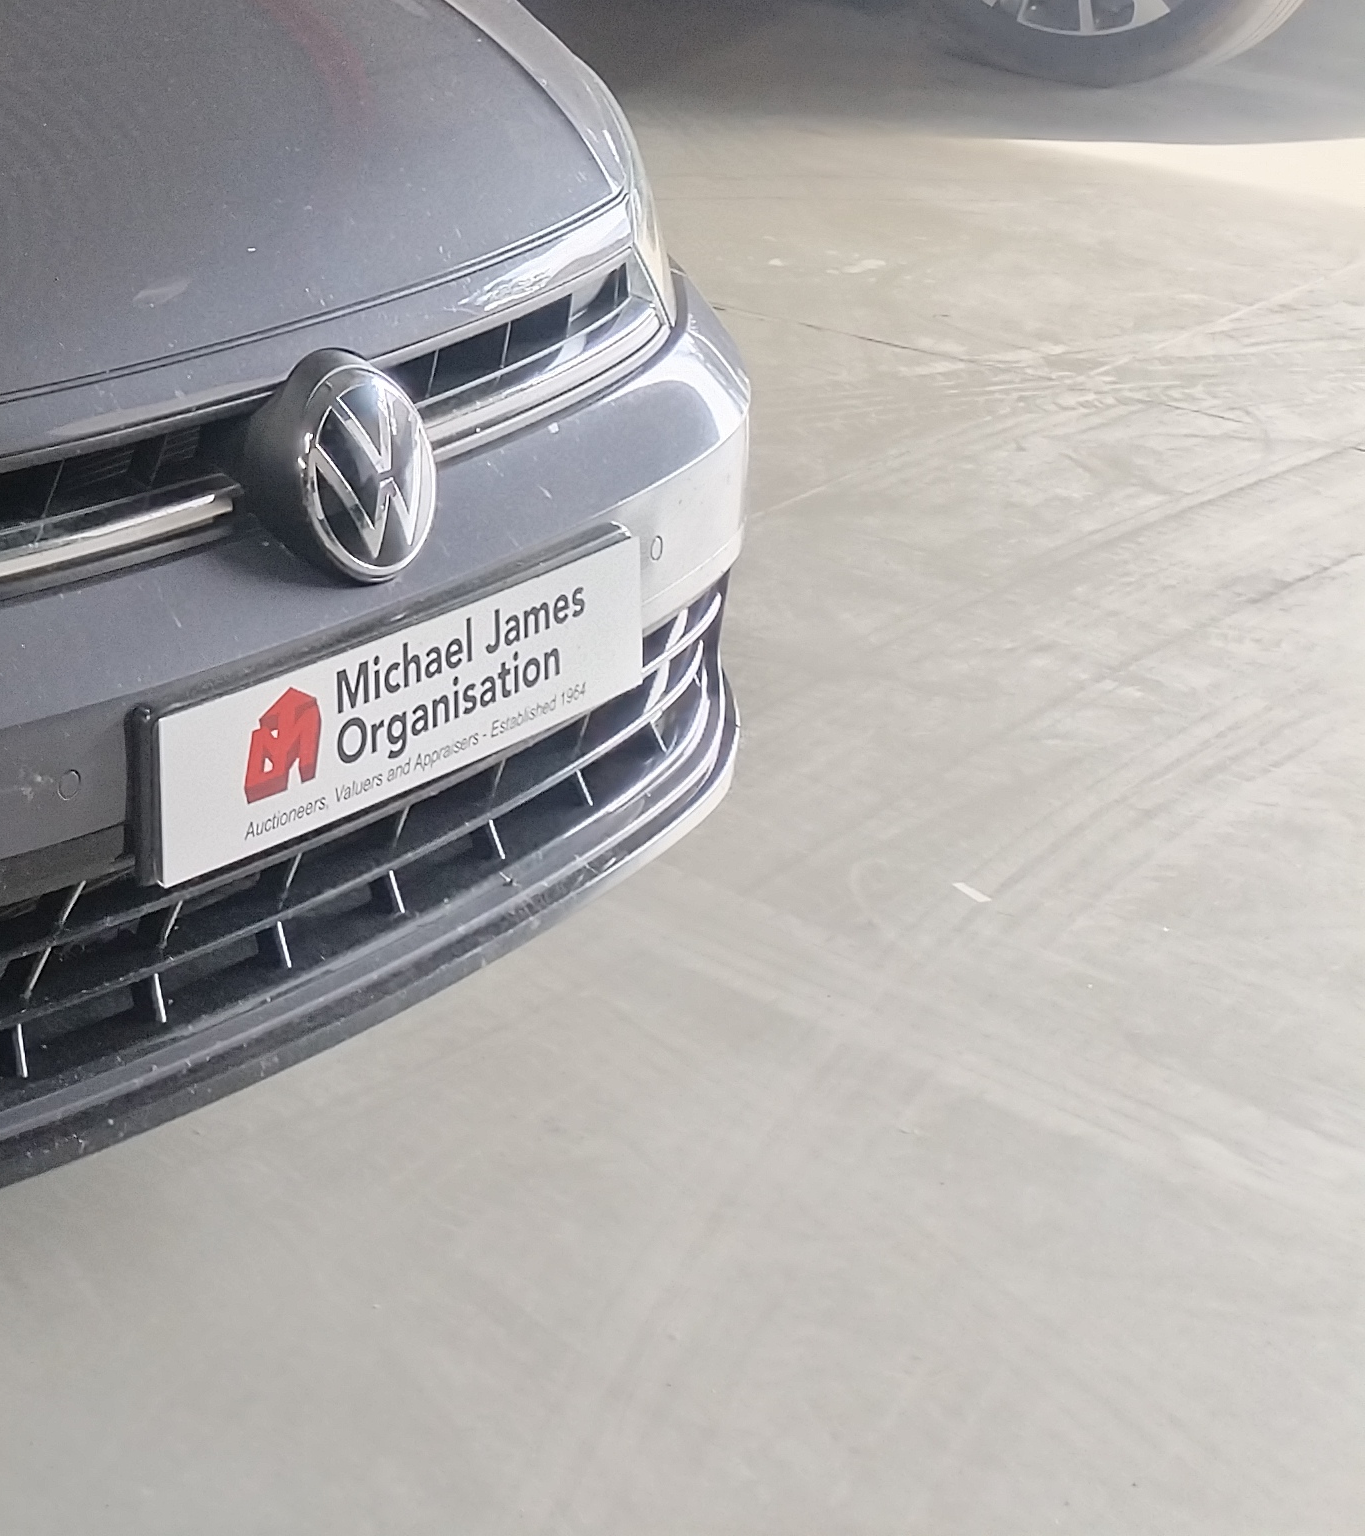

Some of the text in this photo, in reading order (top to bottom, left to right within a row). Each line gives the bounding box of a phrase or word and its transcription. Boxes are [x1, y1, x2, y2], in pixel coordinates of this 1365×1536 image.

[336, 583, 586, 714] Michael James
[336, 647, 561, 766] Organisation
[244, 796, 329, 841] Auctioneers,
[335, 770, 383, 804] Valuers
[387, 759, 411, 783] and
[413, 733, 479, 772] Appraisers
[490, 700, 557, 738] Established
[560, 681, 587, 705] 1964
